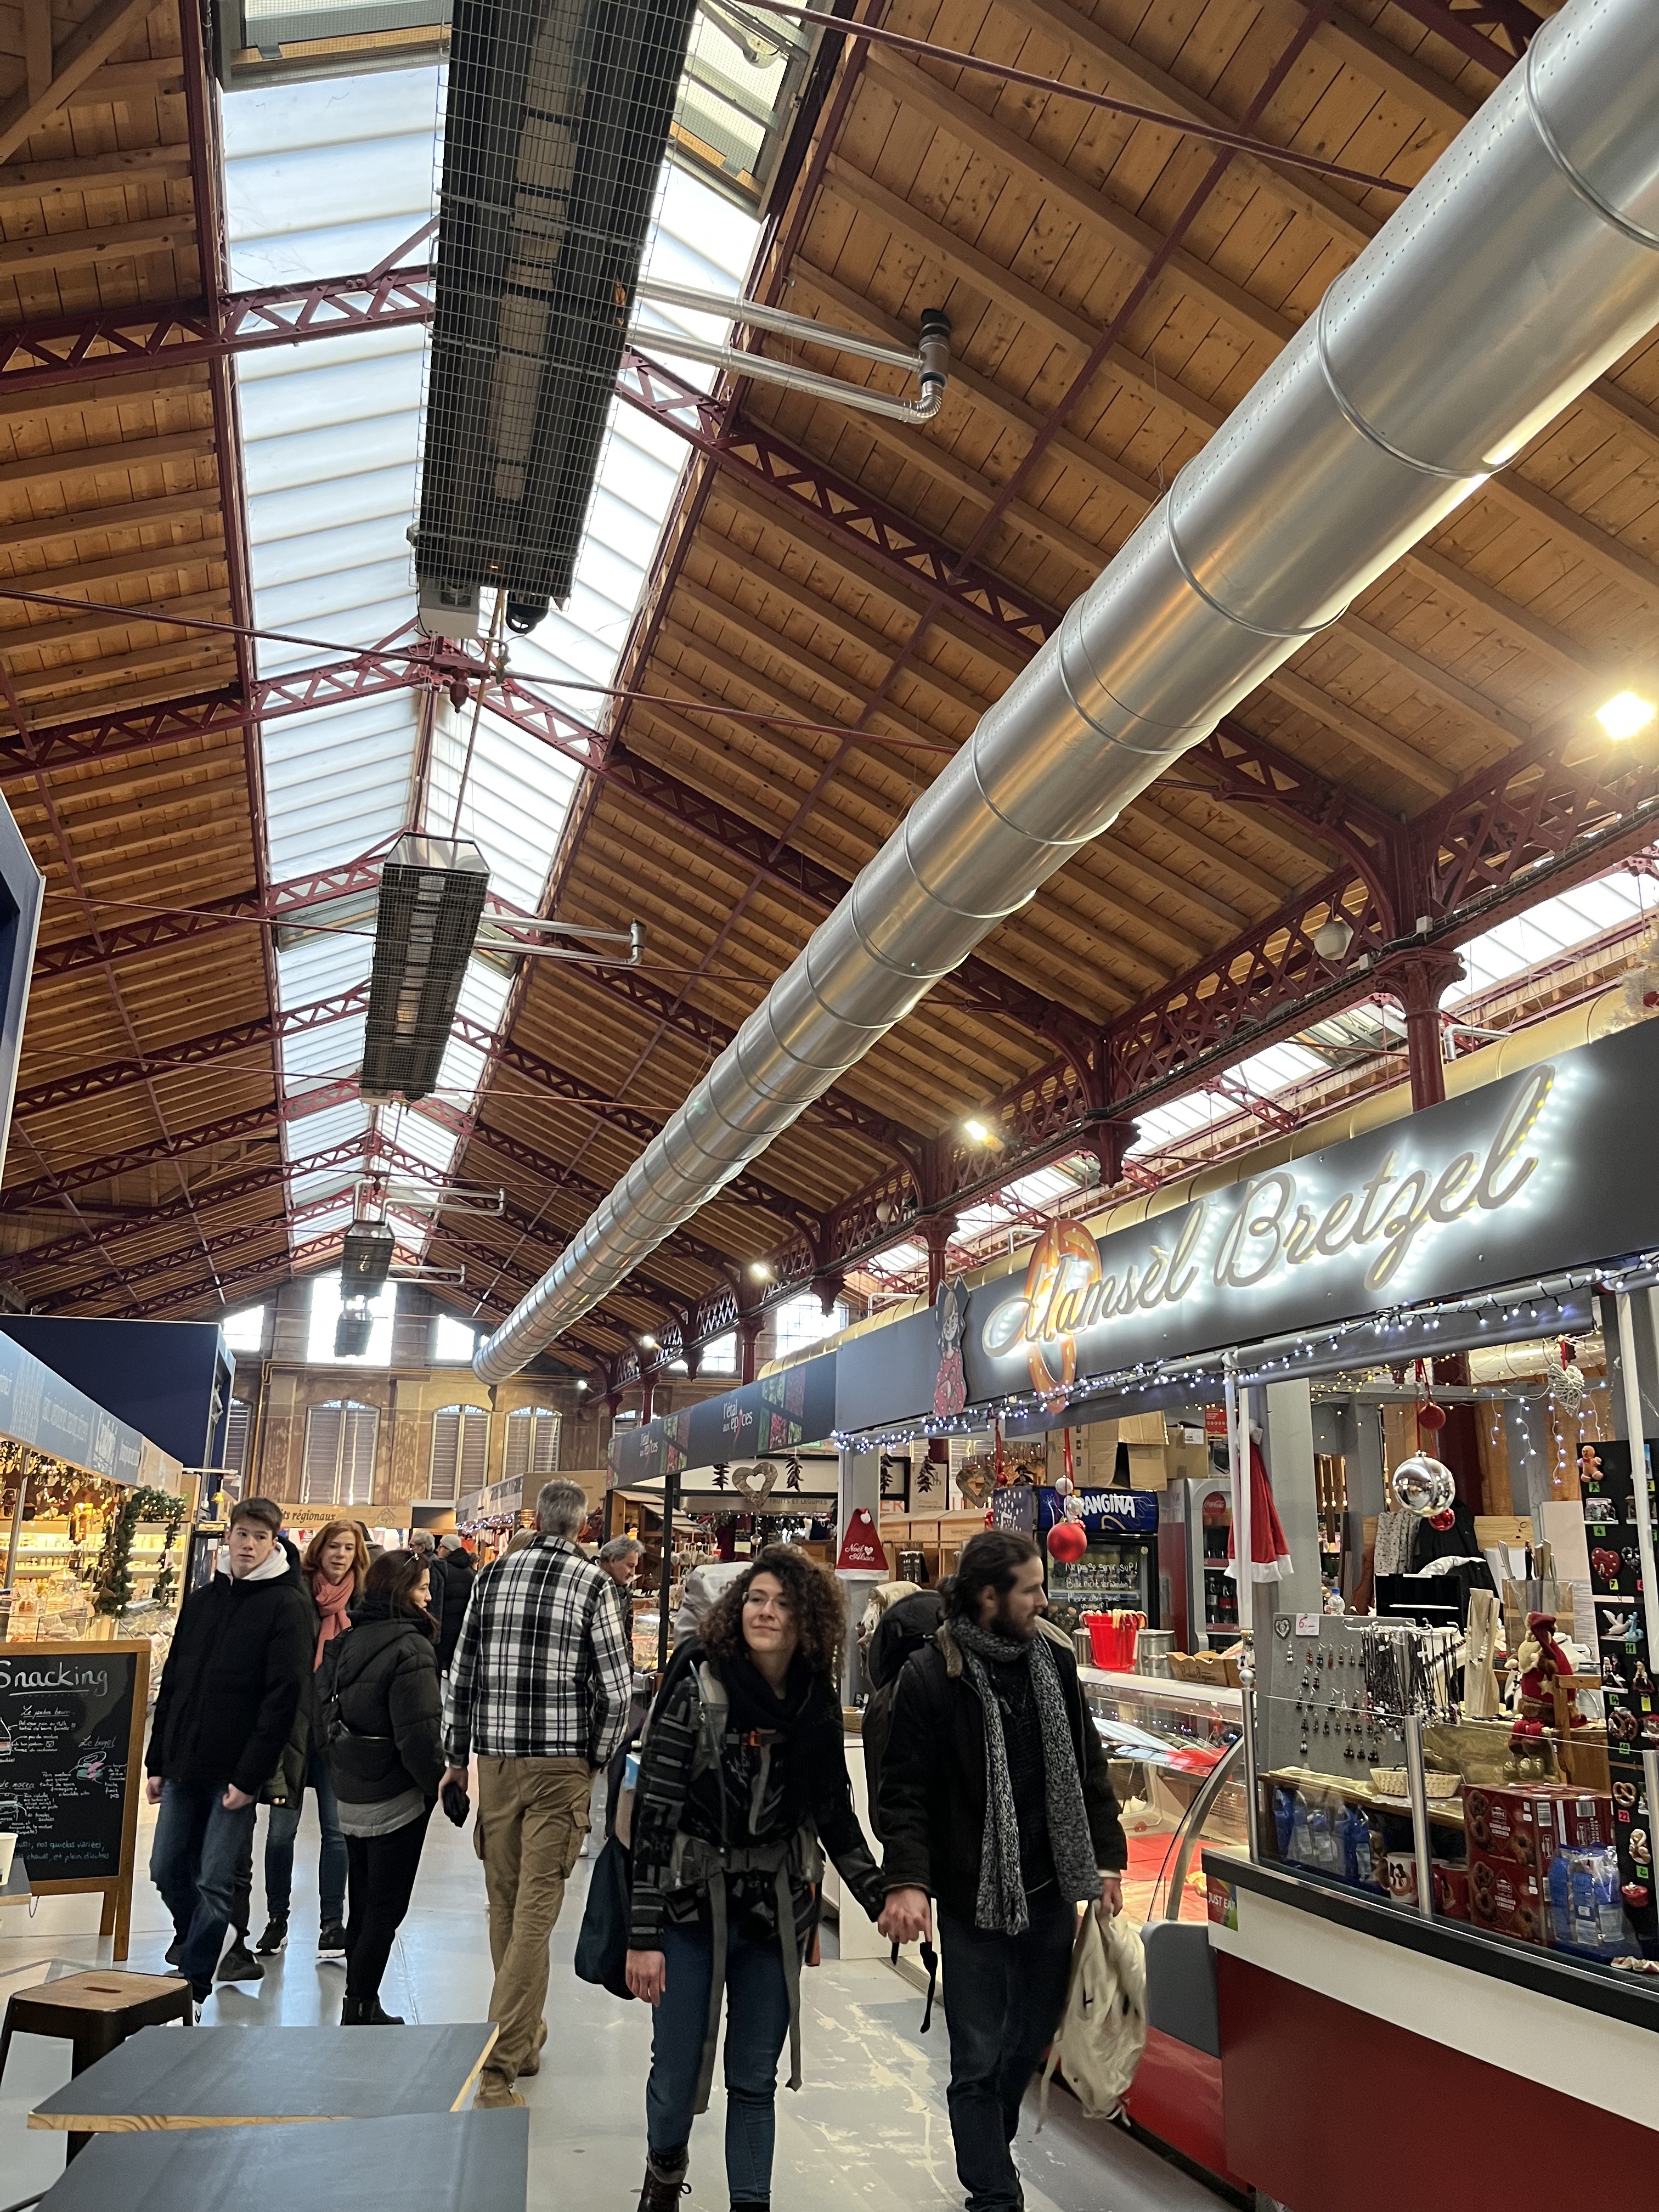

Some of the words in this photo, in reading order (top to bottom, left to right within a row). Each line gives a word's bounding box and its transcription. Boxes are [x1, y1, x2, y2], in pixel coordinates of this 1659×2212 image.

[1214, 1063, 1556, 1290] Bretzel
[723, 1398, 738, 1419] l'étal
[292, 1509, 336, 1523] régionaux
[1597, 1527, 1602, 1535] 4
[844, 1542, 865, 1553] Noël
[1611, 1581, 1616, 1589] 7
[1626, 1644, 1634, 1652] 11
[0, 1660, 108, 1697] Snacking
[78, 1735, 92, 1747] Le
[94, 1735, 116, 1750] bagel
[1620, 1811, 1629, 1820] 22
[65, 1852, 82, 1863] plein
[1209, 1892, 1223, 1906] JUST
[1223, 1898, 1235, 1911] EAT
